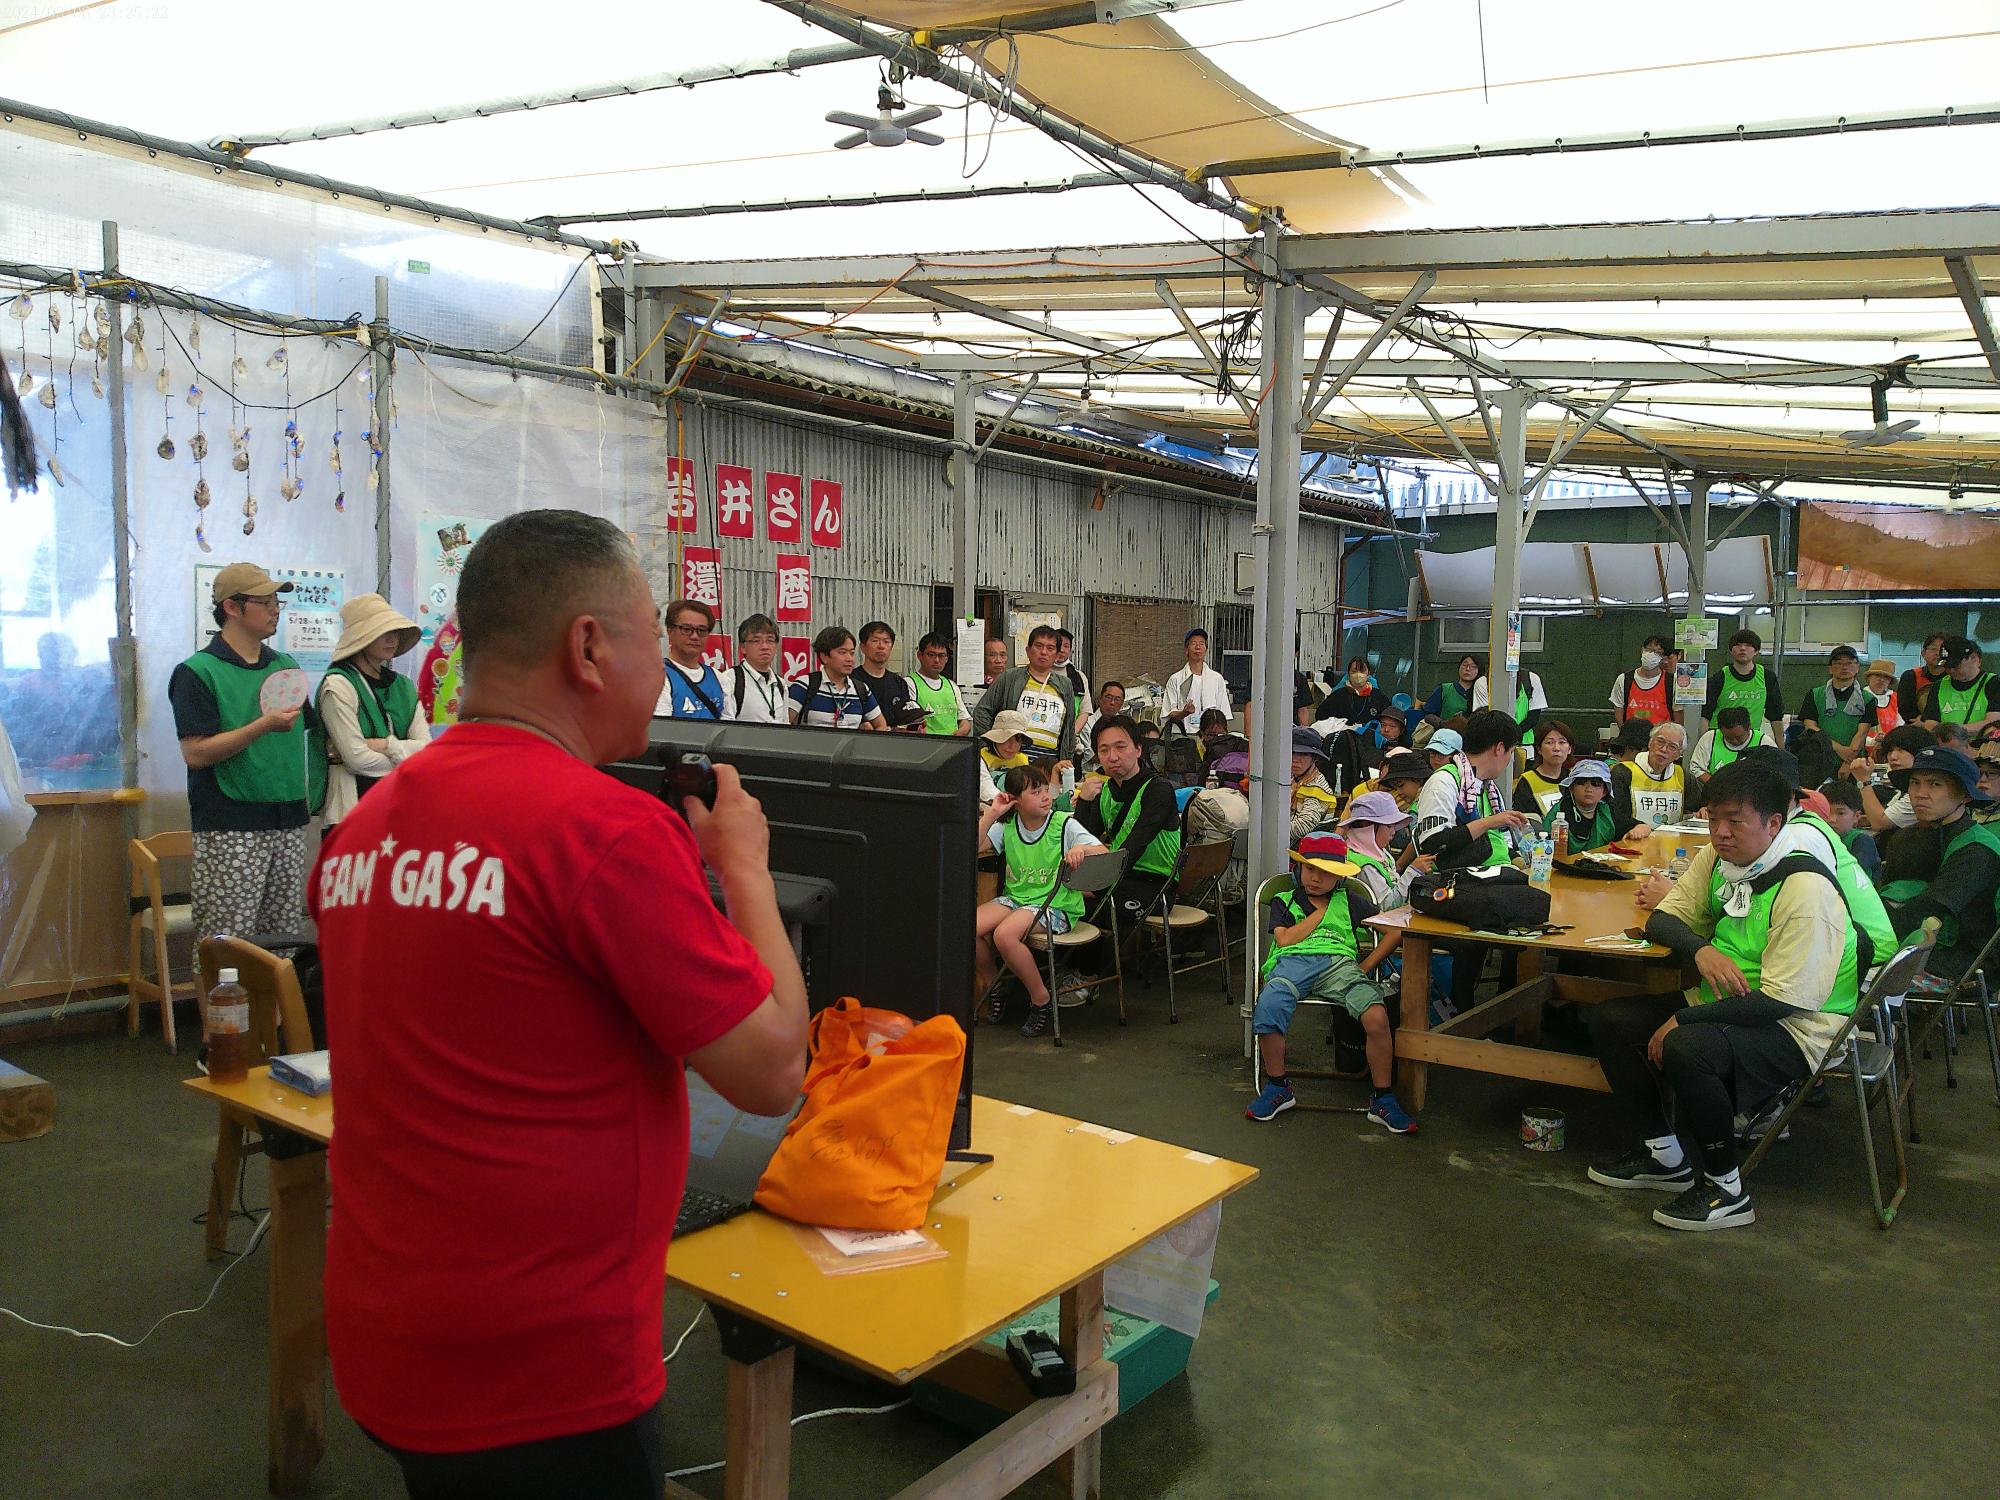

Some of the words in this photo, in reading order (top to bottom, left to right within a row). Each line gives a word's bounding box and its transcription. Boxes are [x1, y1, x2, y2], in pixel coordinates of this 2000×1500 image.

[1021, 695, 1060, 713] 伊丹市
[1640, 796, 1679, 812] 伊丹市
[320, 849, 378, 910] EAM
